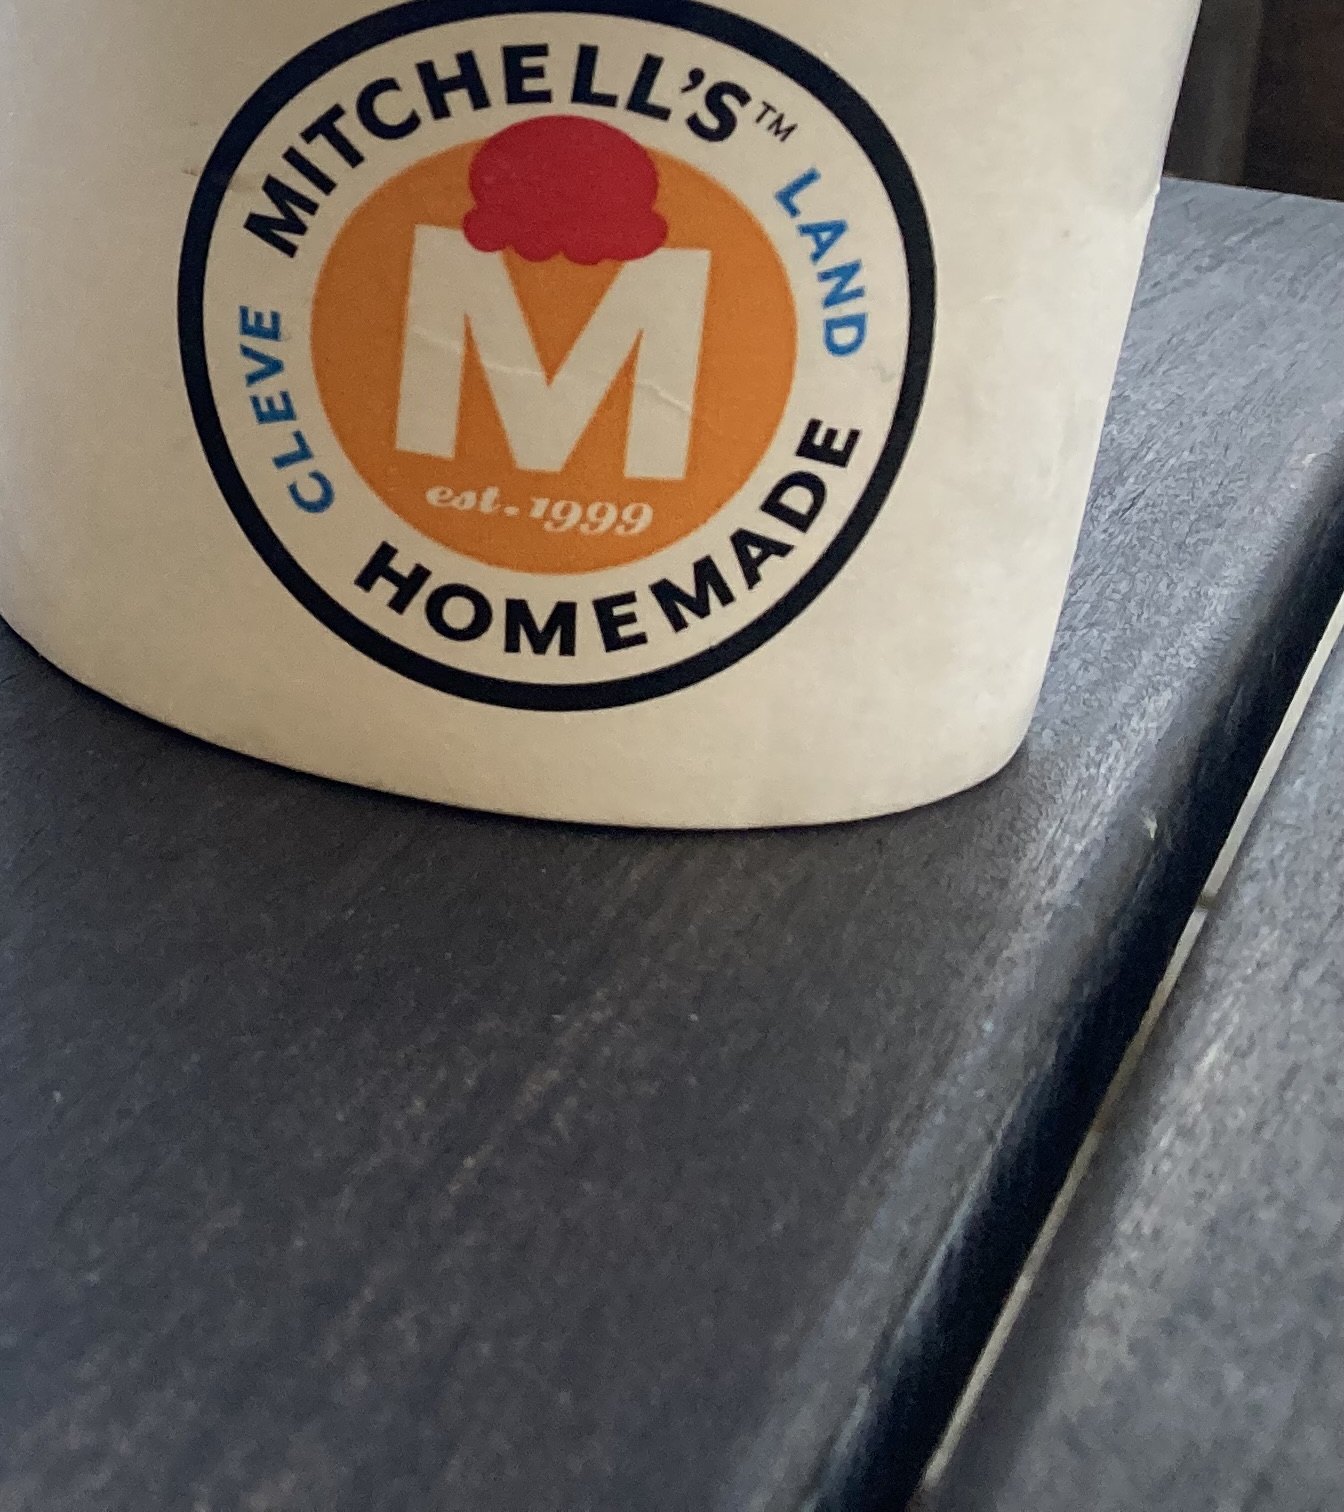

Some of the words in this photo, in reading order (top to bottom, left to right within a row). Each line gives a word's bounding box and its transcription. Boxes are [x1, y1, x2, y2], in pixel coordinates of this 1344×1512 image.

[242, 42, 752, 259] MITCHELL'S
[238, 305, 336, 515] CLEVE
[774, 167, 867, 358] LAND
[395, 224, 712, 482] M
[353, 418, 862, 657] HOMEMADE
